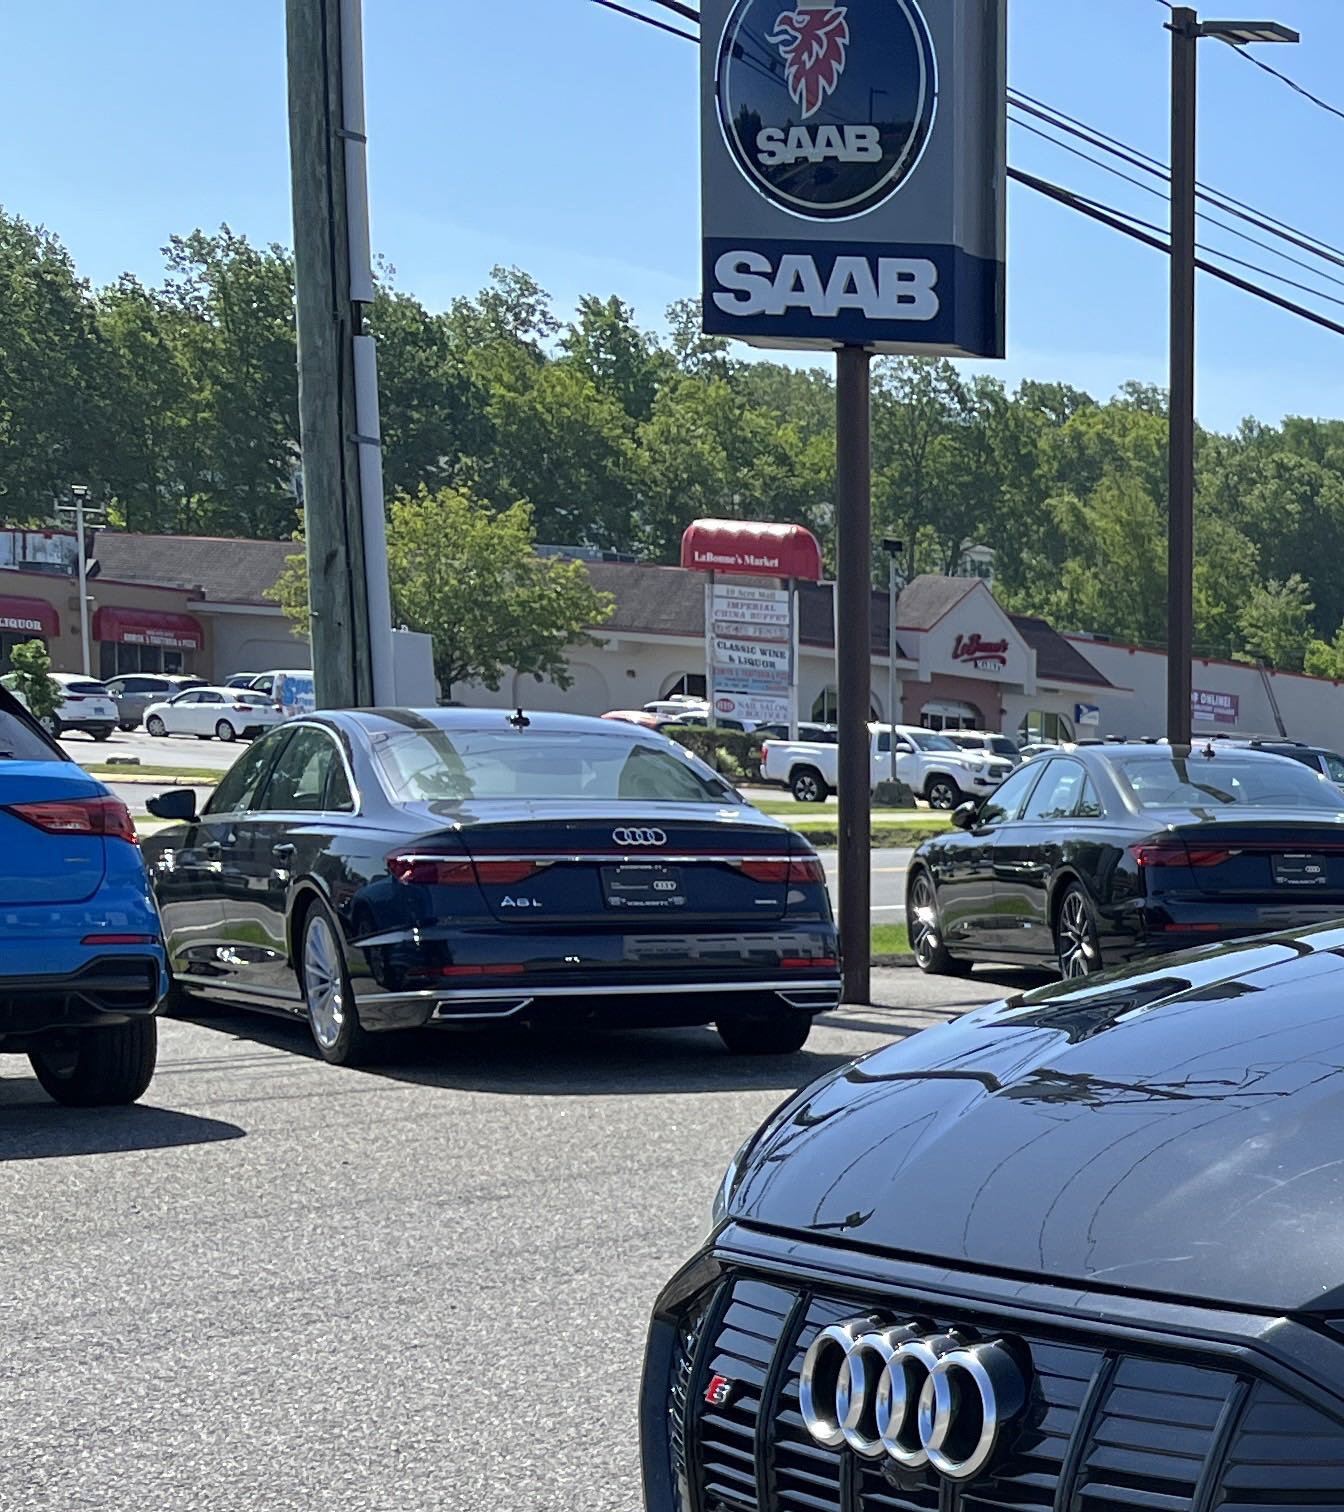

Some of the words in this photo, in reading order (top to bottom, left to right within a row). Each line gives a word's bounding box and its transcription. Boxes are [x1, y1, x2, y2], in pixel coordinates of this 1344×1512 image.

[756, 125, 883, 166] SAAB
[712, 250, 940, 322] SAAB
[694, 551, 743, 565] LaBonne's
[743, 554, 779, 568] Market
[727, 600, 777, 612] IMPERIAL
[714, 609, 746, 619] CHINA
[750, 612, 788, 622] BUFFET
[716, 640, 757, 655] CLASSIC
[760, 647, 787, 660] WINE
[738, 656, 776, 670] LIQUOR
